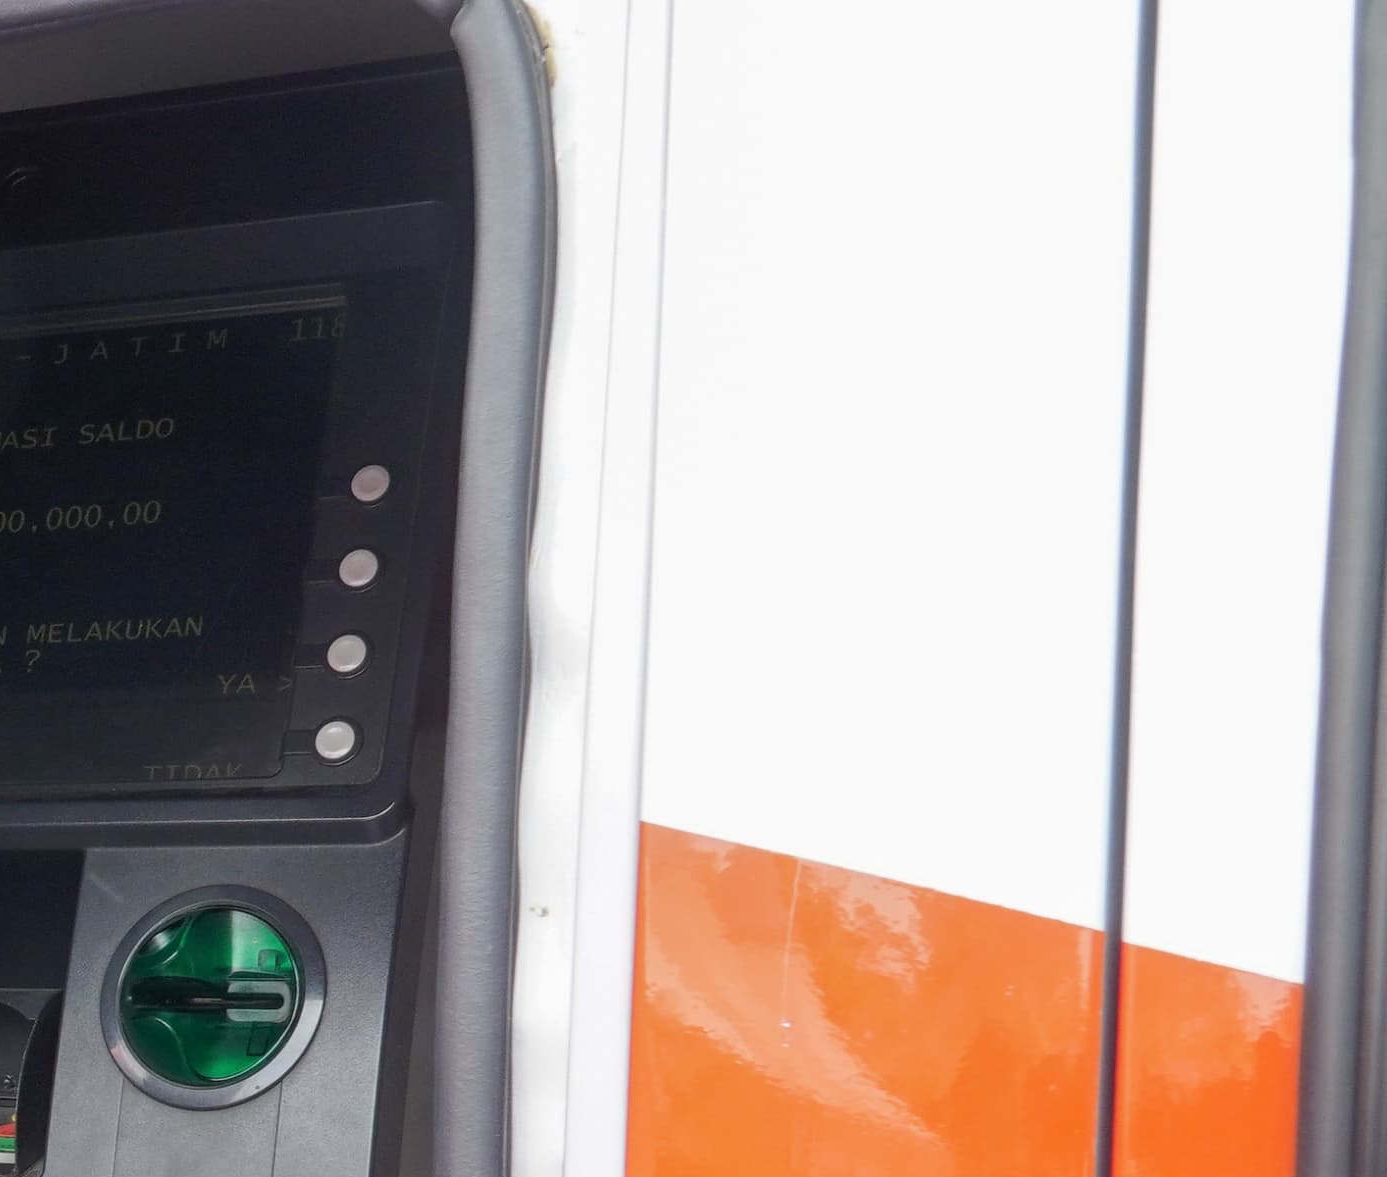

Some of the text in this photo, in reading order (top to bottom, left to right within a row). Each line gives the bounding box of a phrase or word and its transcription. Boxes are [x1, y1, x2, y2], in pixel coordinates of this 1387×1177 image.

[78, 418, 174, 445] SALDO
[26, 616, 204, 644] MELAKUKAN
[217, 673, 258, 695] YA
